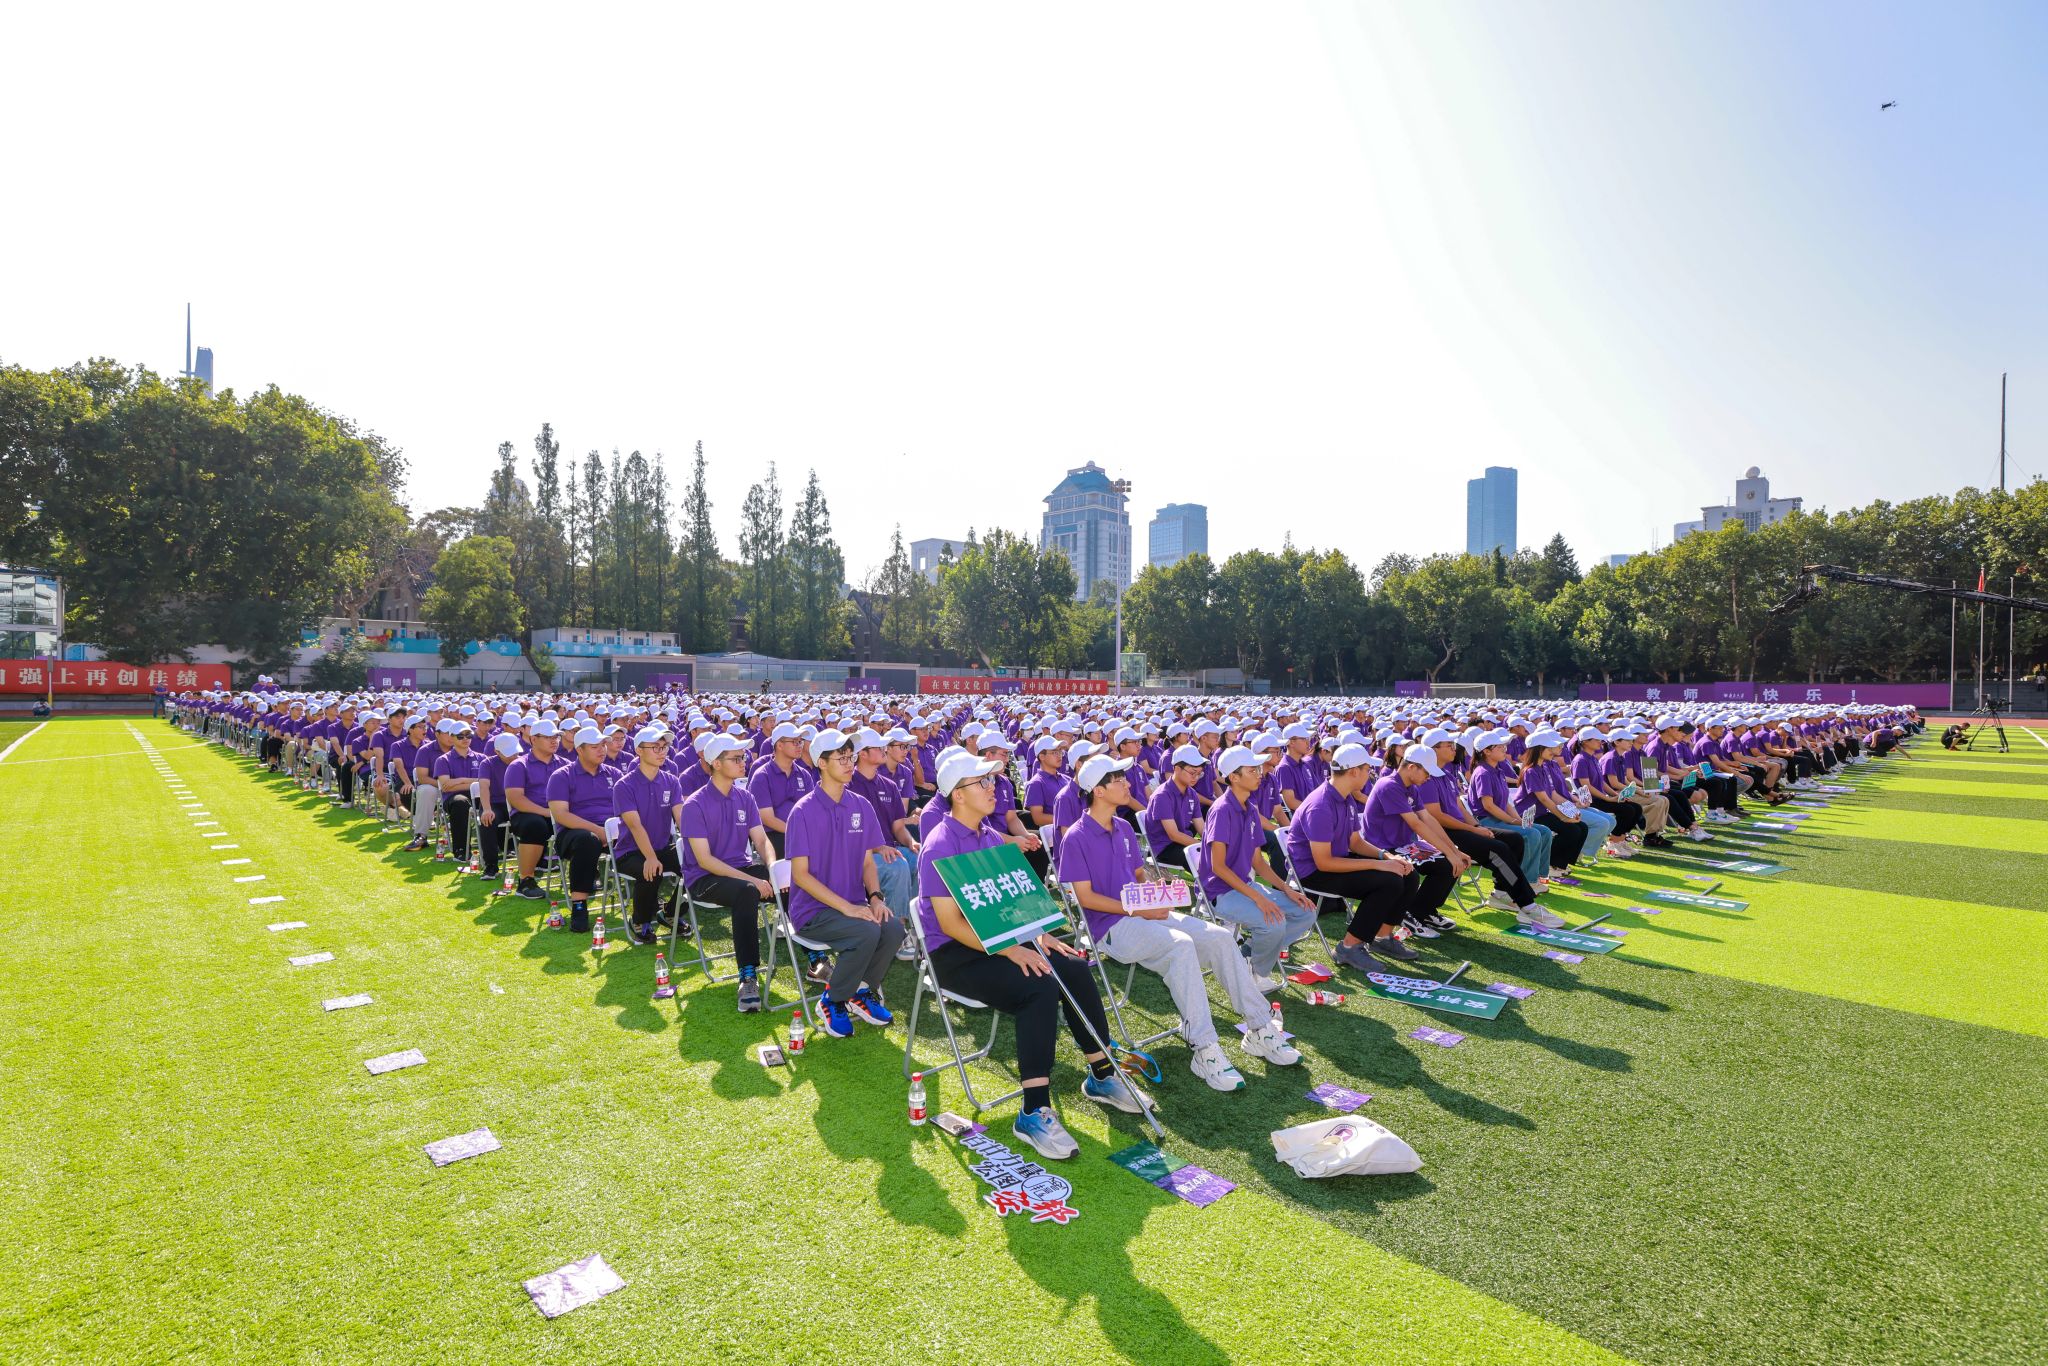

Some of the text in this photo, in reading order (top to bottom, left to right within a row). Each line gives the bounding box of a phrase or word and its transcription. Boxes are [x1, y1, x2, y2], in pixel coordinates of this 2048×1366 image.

[960, 868, 1037, 911] 安邦书院
[1123, 881, 1187, 905] 南京大学
